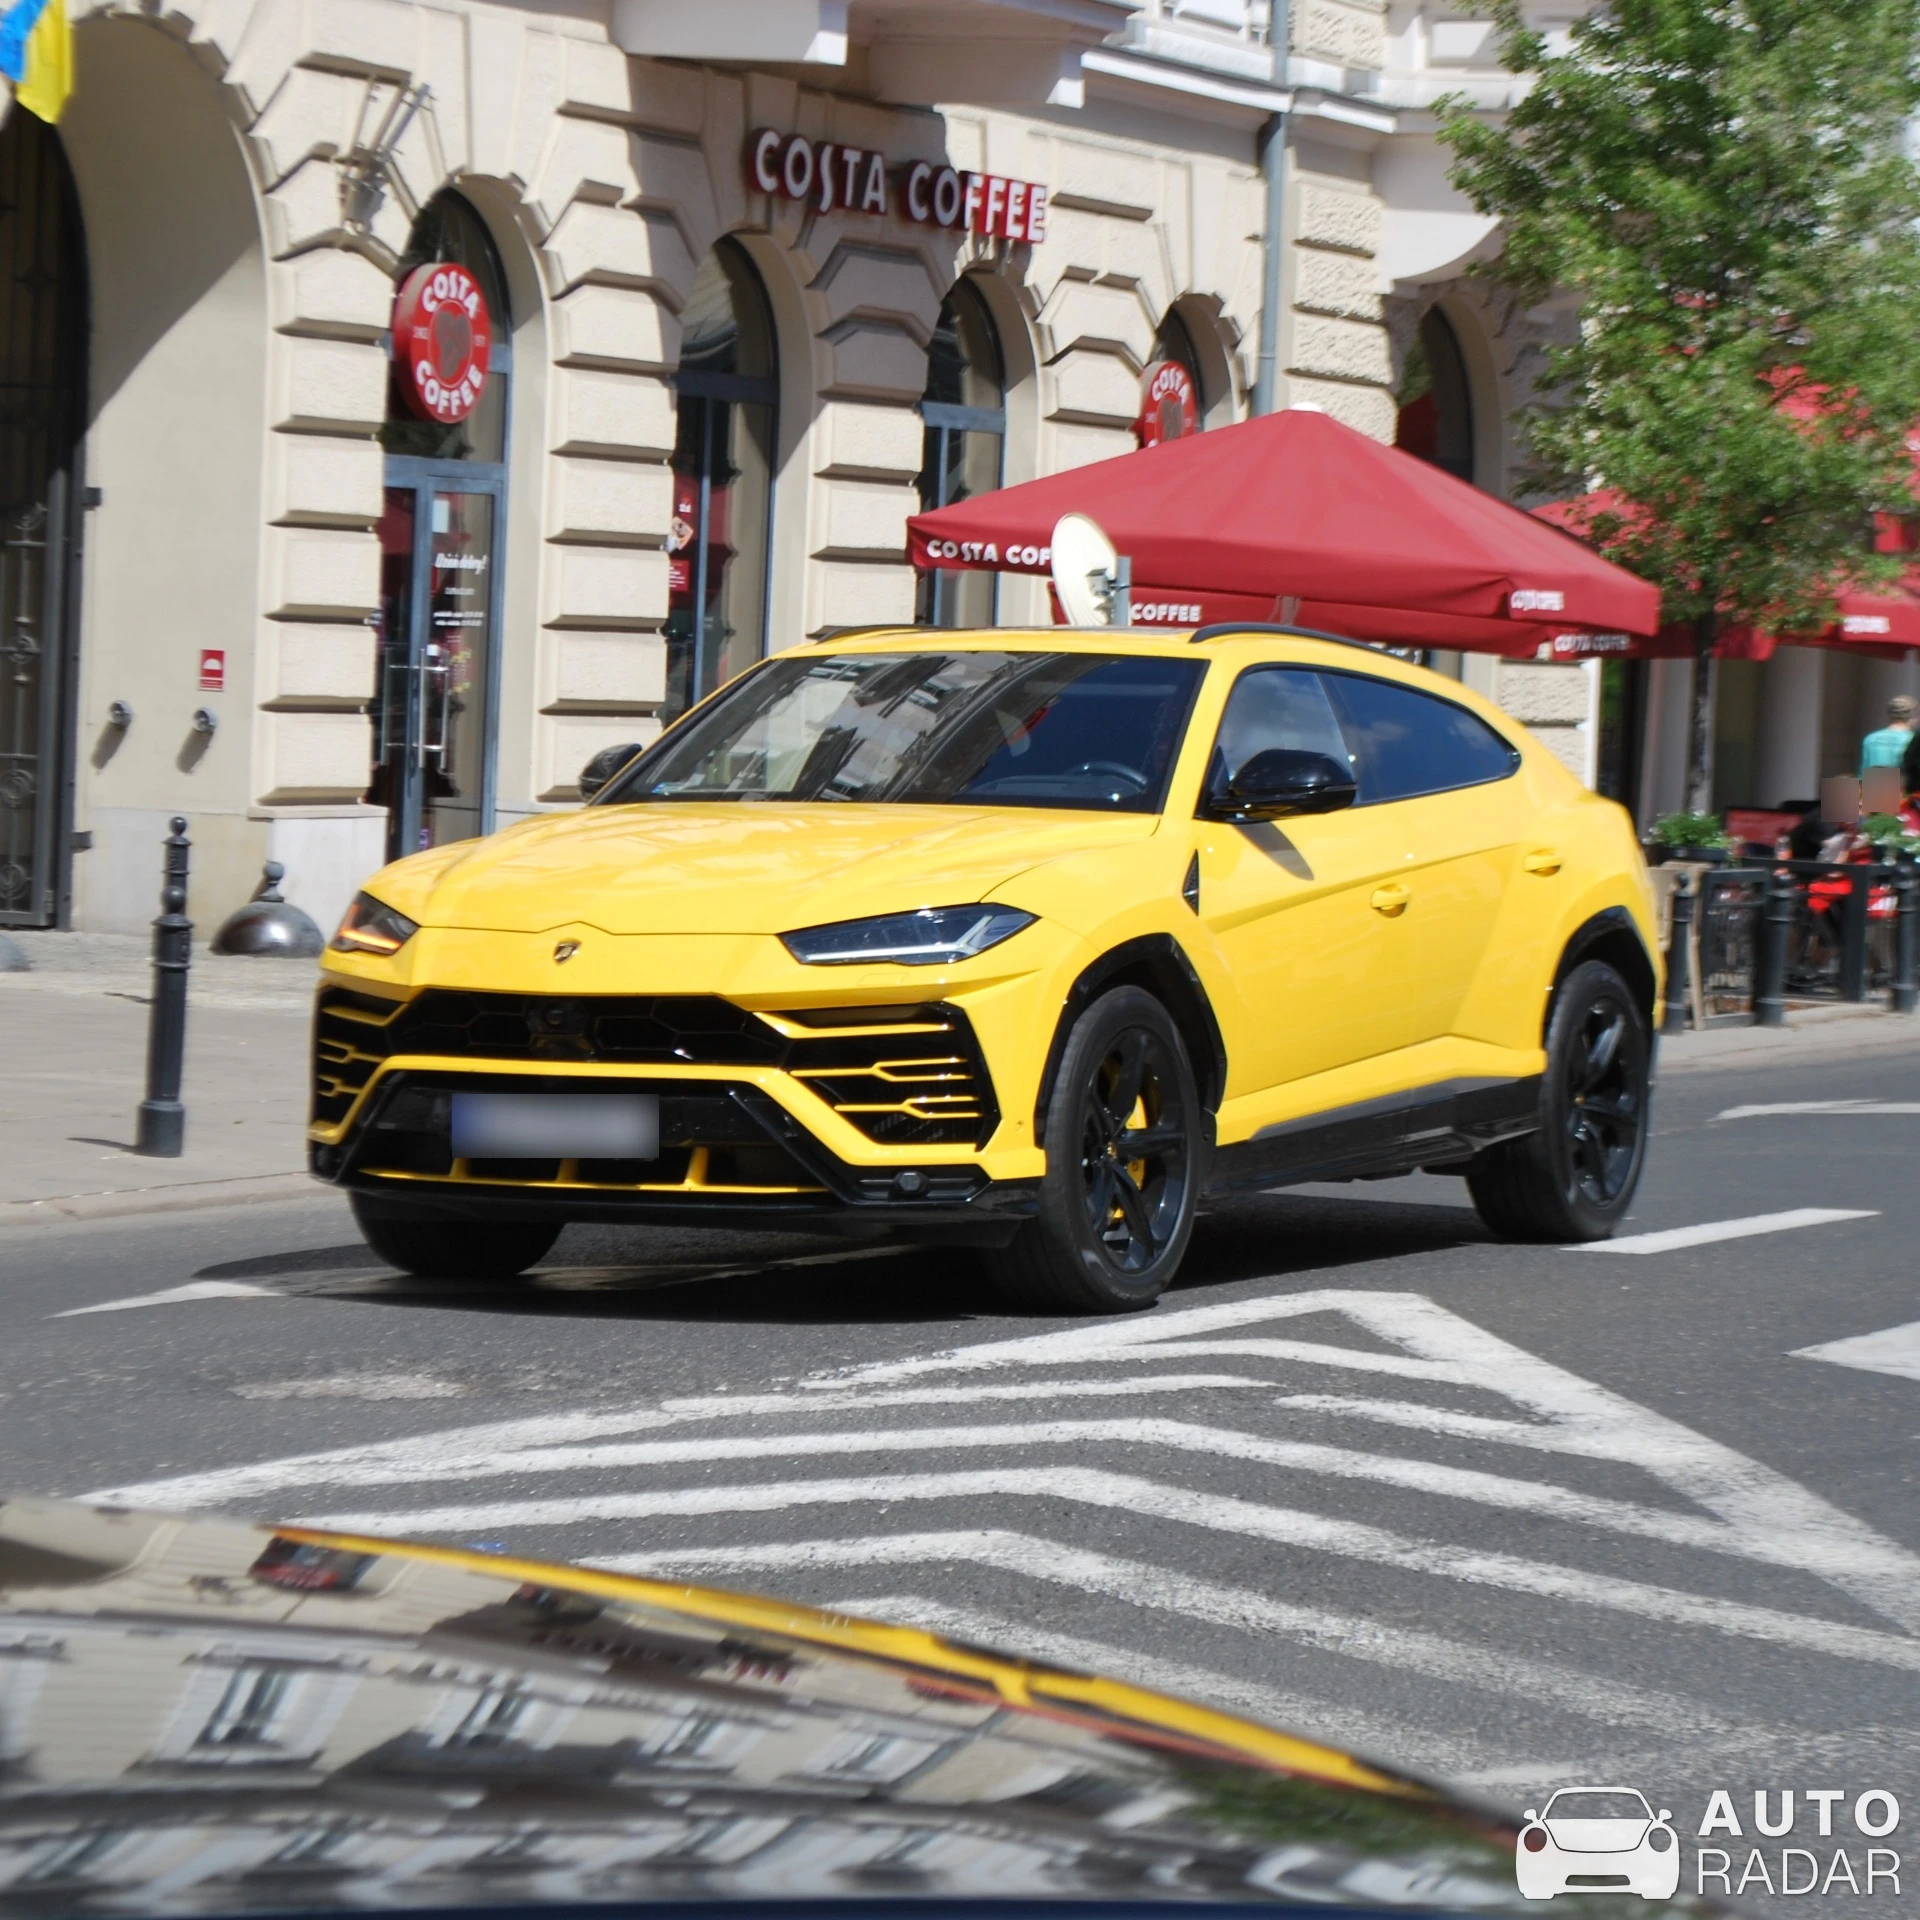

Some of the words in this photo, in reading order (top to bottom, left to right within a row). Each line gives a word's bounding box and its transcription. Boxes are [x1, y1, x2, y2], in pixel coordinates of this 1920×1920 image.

[755, 130, 886, 213] COSTA
[908, 162, 1046, 241] COFFEE
[422, 271, 480, 319] COSTA
[416, 360, 483, 416] COFFEE
[1152, 367, 1190, 405] COSTA
[926, 539, 998, 562] COSTA
[1005, 545, 1051, 565] COF
[1131, 603, 1200, 622] COFFEE
